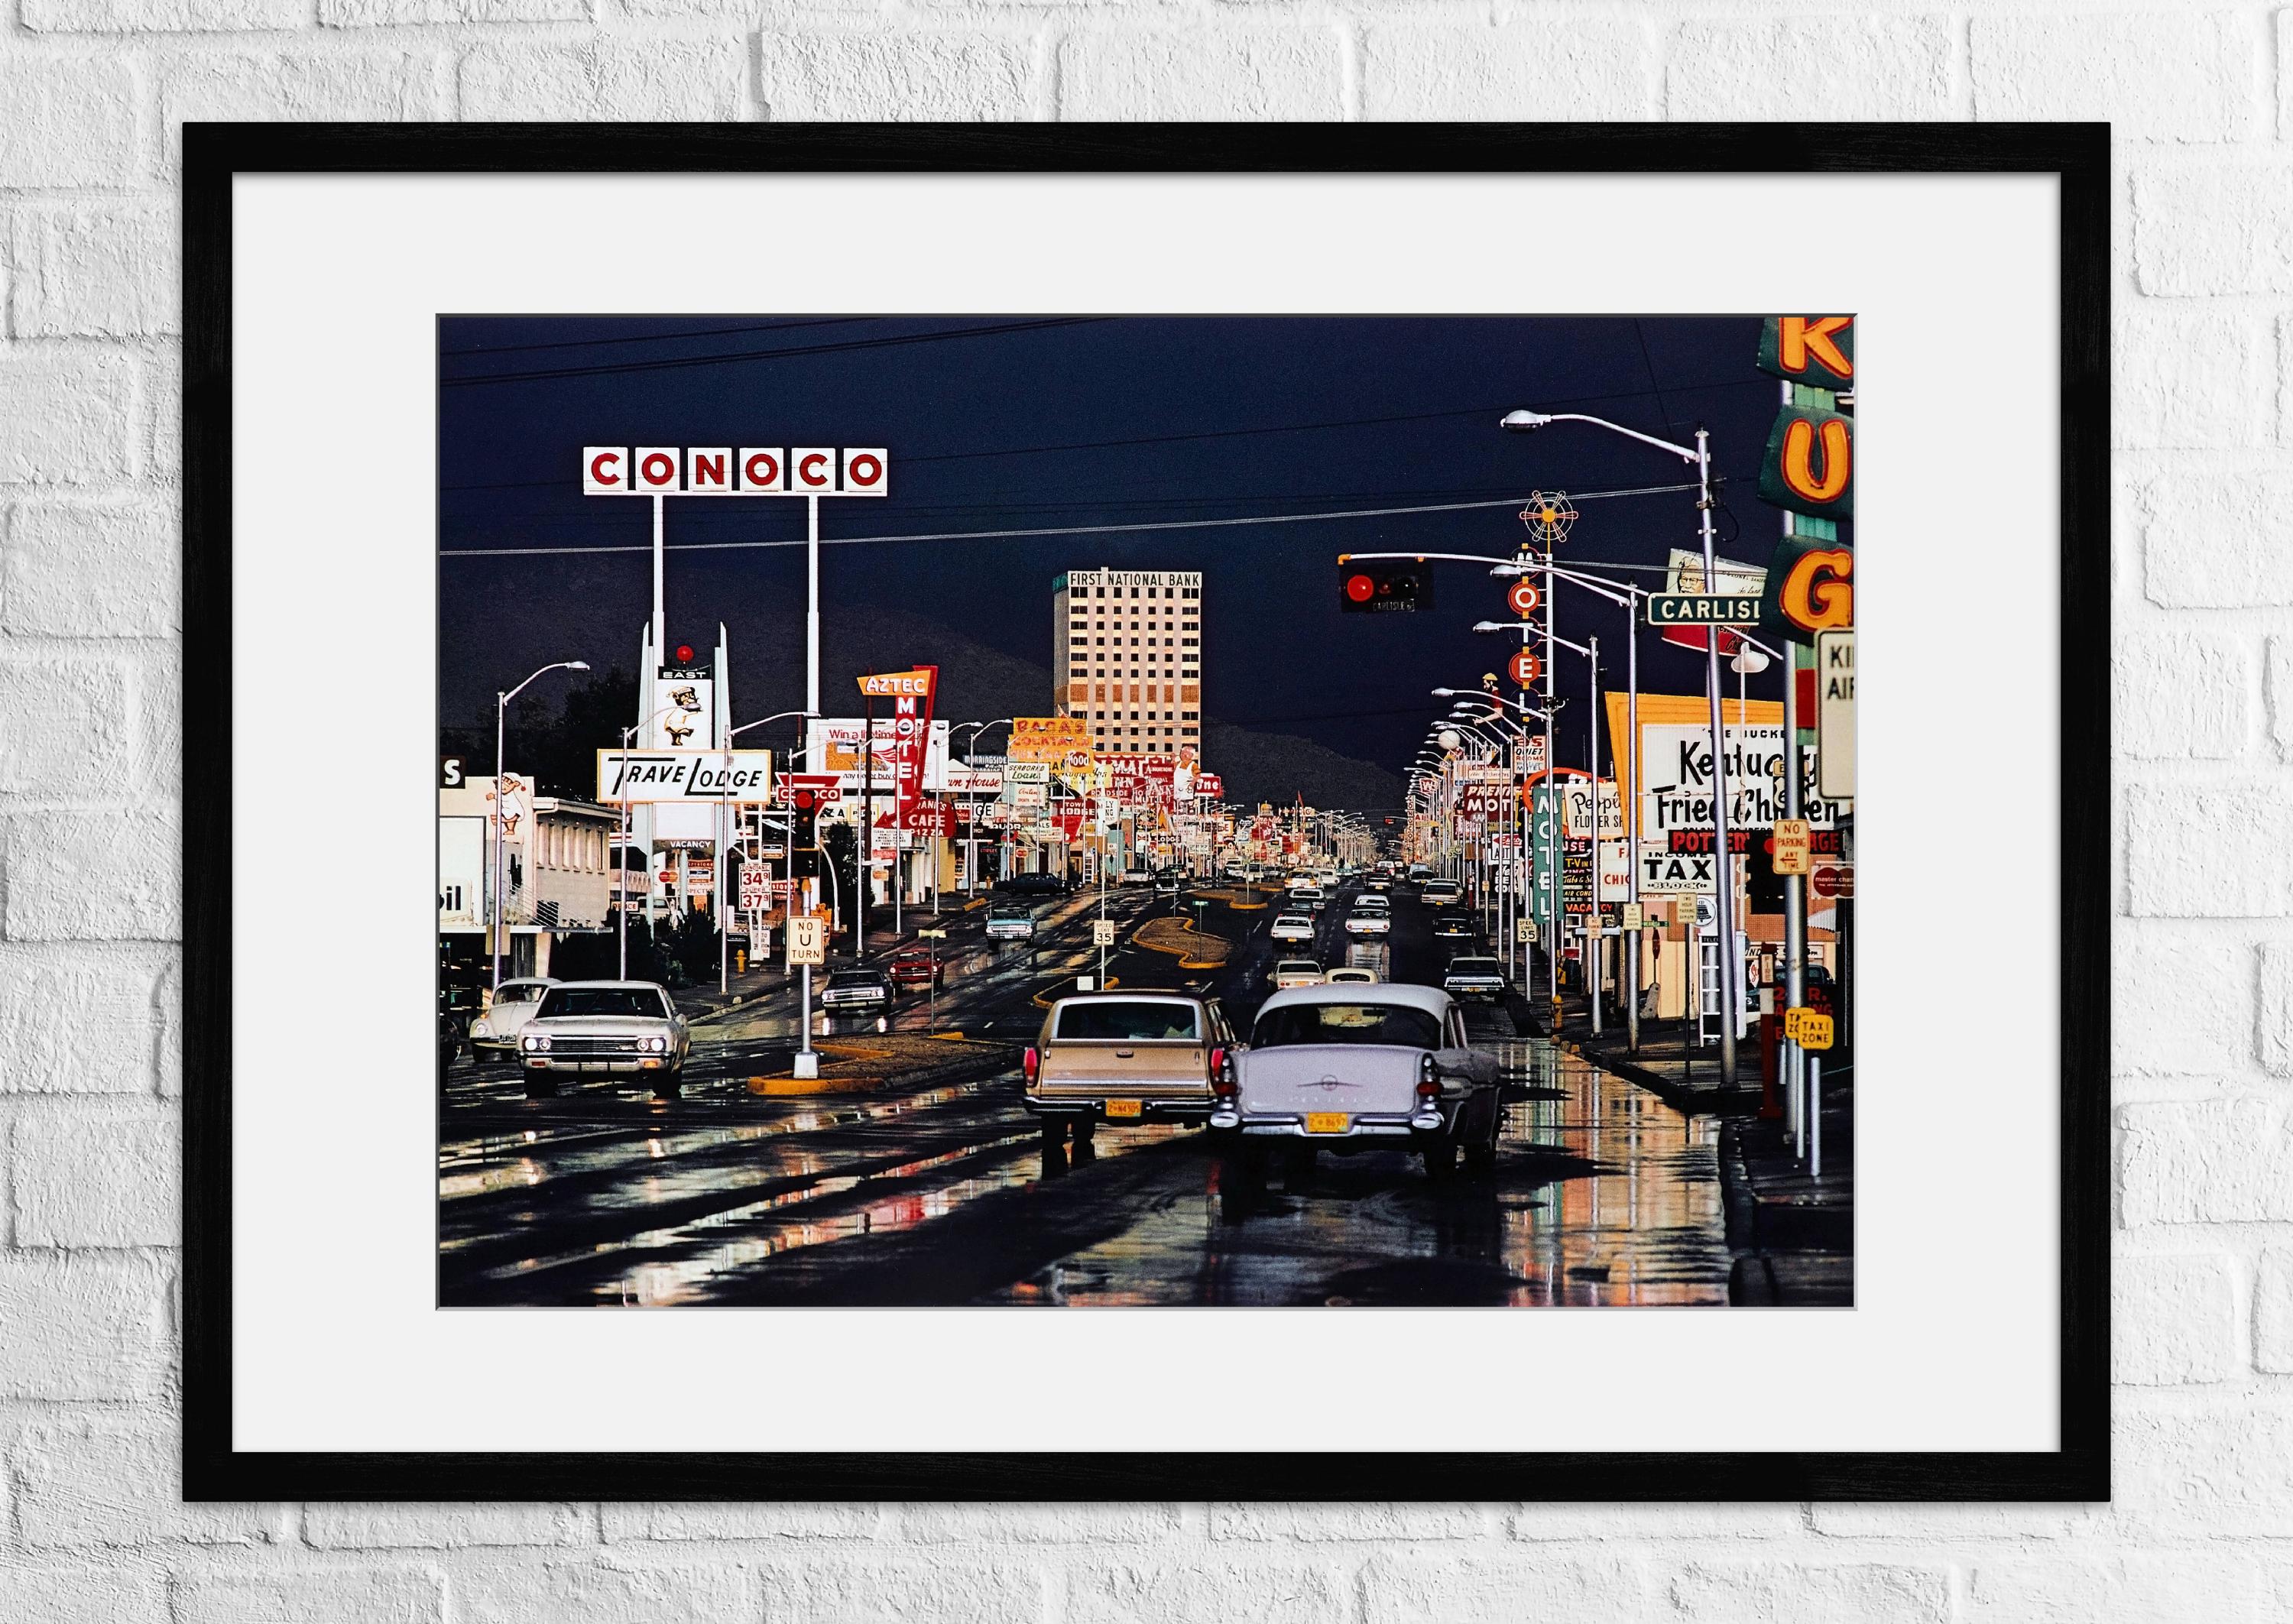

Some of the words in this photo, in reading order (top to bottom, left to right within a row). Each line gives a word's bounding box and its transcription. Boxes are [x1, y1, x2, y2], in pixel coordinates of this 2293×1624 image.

[591, 452, 882, 486] CONOCO
[1071, 573, 1101, 585] FIRST
[1108, 573, 1163, 586] NATIONAL
[1169, 574, 1200, 586] BANK
[1661, 600, 1760, 619] CARLISL
[1514, 552, 1538, 715] MOTEL
[865, 677, 926, 693] AZTEC
[829, 728, 847, 739] Win
[861, 728, 896, 740] lietime
[1708, 729, 1731, 738] TE
[897, 696, 915, 801] MOTEL
[1516, 747, 1543, 756] QUIET
[878, 773, 891, 782] buy
[965, 773, 1001, 789] House
[908, 814, 945, 827] CAFE
[909, 828, 945, 837] PIZZA
[1783, 824, 1801, 834] NO
[670, 841, 712, 849] VACANCY
[1777, 838, 1806, 848] PARKING
[1537, 795, 1559, 918] MOTEL
[1643, 859, 1712, 880] TAX
[1652, 881, 1700, 890] BLOCK
[1565, 903, 1613, 913] VACACY
[799, 934, 812, 946] U
[1096, 932, 1112, 942] 35
[1521, 931, 1536, 940] 35
[792, 949, 820, 958] TURN
[1802, 1020, 1830, 1030] TAXI
[1802, 1032, 1829, 1043] ZONE
